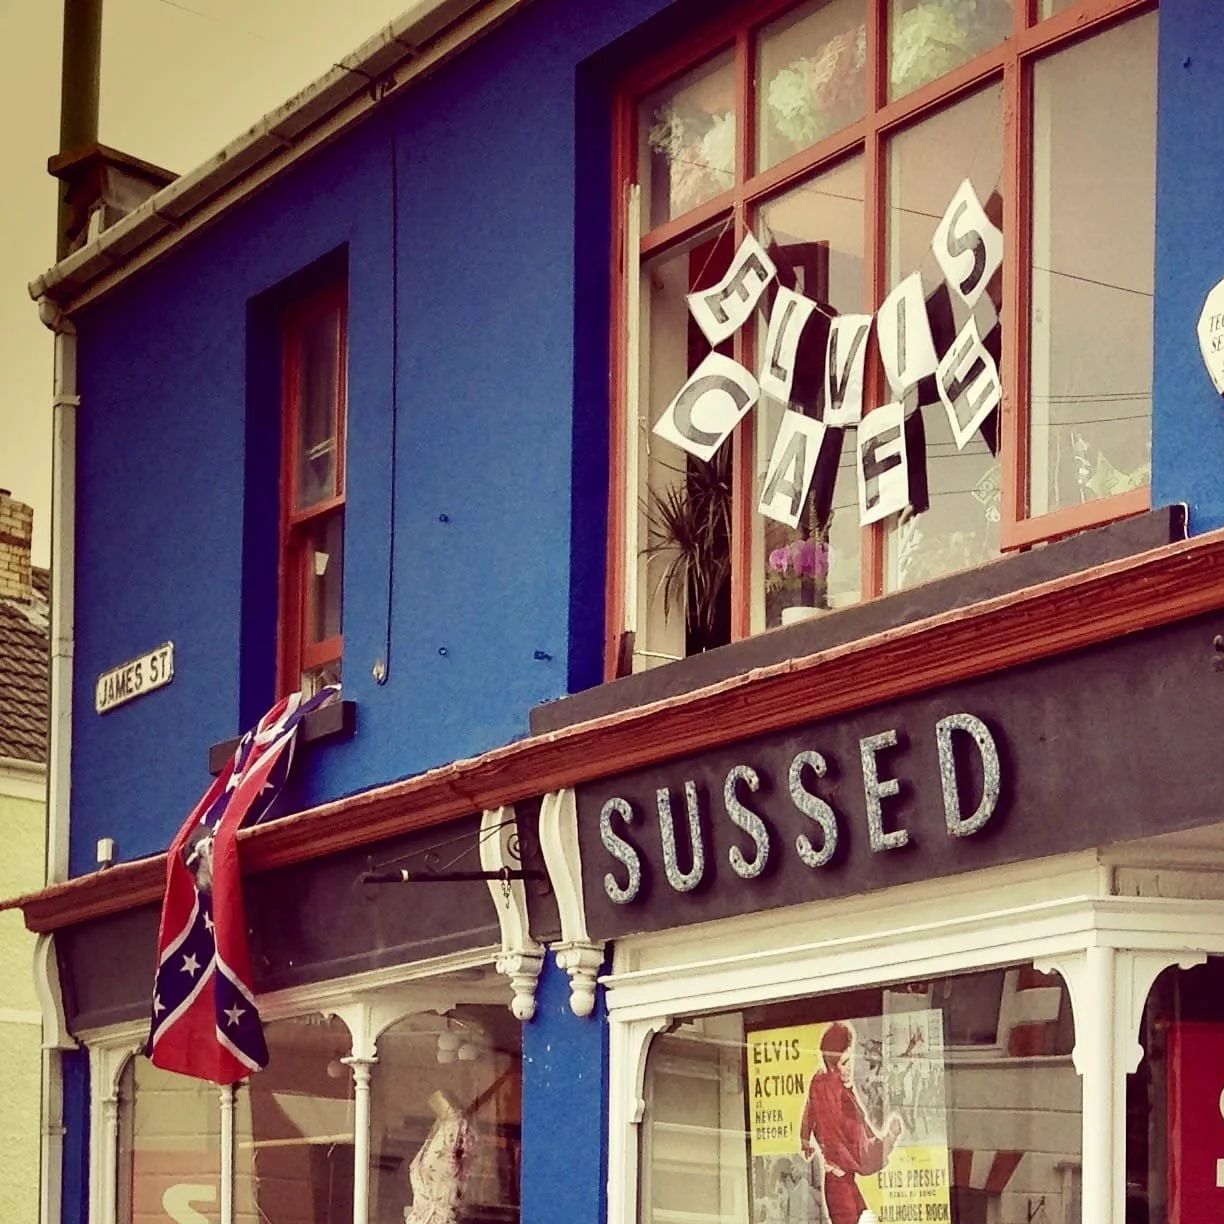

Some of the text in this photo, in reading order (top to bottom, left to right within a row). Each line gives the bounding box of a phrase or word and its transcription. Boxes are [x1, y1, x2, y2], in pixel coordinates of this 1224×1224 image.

[703, 199, 987, 410] ELVIS
[672, 334, 996, 516] CAFE
[100, 650, 168, 708] JAMES ST
[600, 713, 1001, 904] SUSSED
[753, 1039, 801, 1064] ELVIS
[755, 1074, 805, 1098] ACTION
[756, 1109, 784, 1124] NEVER
[878, 1168, 946, 1188] ELVIS PRESLEY
[879, 1203, 949, 1222] JAILHOUSE ROCK
